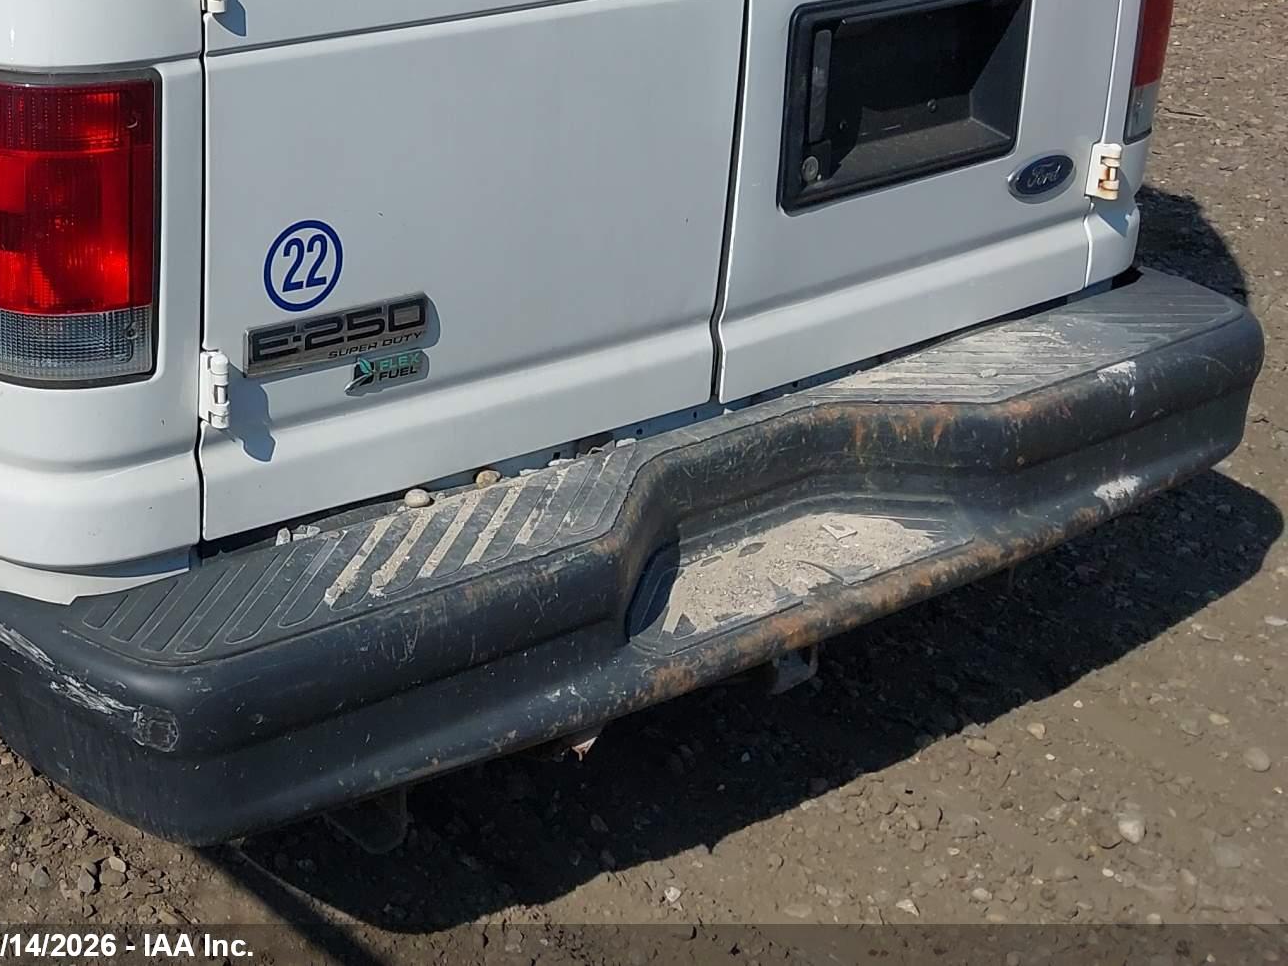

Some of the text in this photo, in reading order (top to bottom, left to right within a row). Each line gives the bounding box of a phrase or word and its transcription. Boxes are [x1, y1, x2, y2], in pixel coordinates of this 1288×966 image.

[1028, 161, 1062, 186] Ford
[282, 233, 328, 292] 22
[327, 332, 424, 360] SUPER DUTY
[378, 365, 419, 382] FUEL
[379, 353, 421, 371] FLEX
